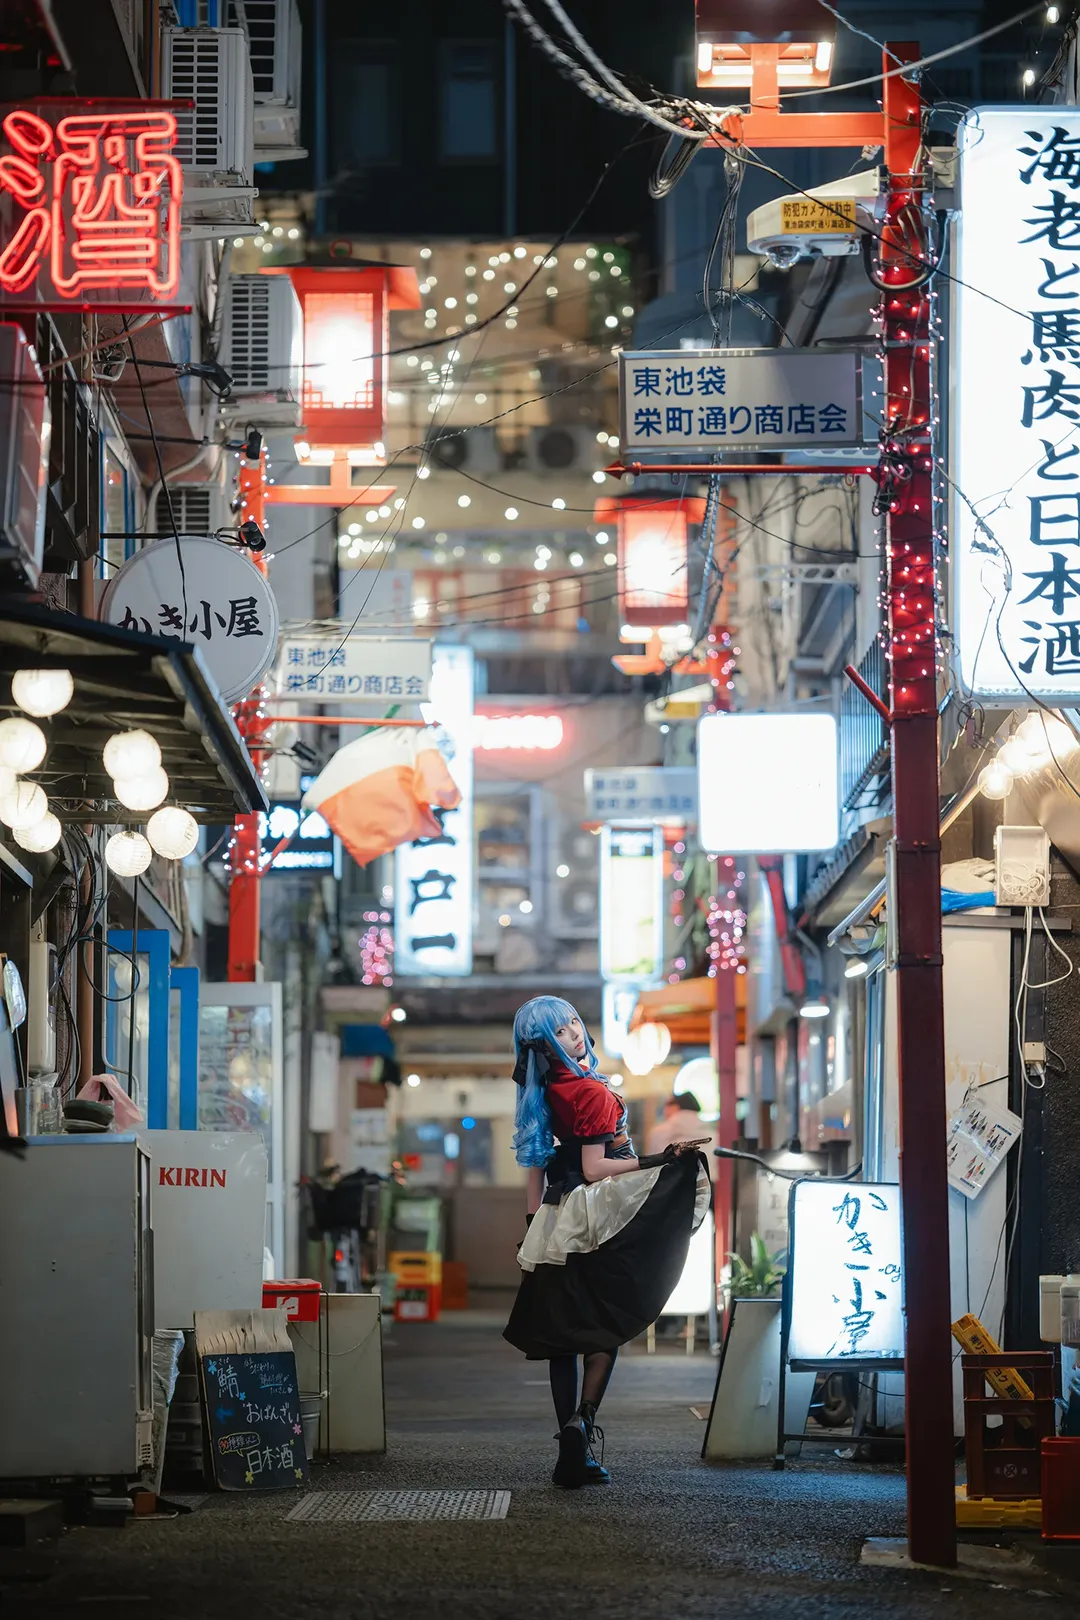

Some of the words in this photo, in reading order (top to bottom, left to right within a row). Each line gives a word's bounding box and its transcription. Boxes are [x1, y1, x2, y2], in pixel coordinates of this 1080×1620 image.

[0, 110, 182, 300] 酒
[632, 366, 727, 398] 東池袋
[1016, 126, 1080, 676] 海老と馬肉と日本酒
[633, 403, 848, 438] 栄町通り商店会
[287, 647, 347, 667] 東池袋
[287, 674, 424, 695] 栄町通り商店会
[158, 1167, 227, 1188] KIRIN
[247, 1443, 294, 1474] 日本酒
